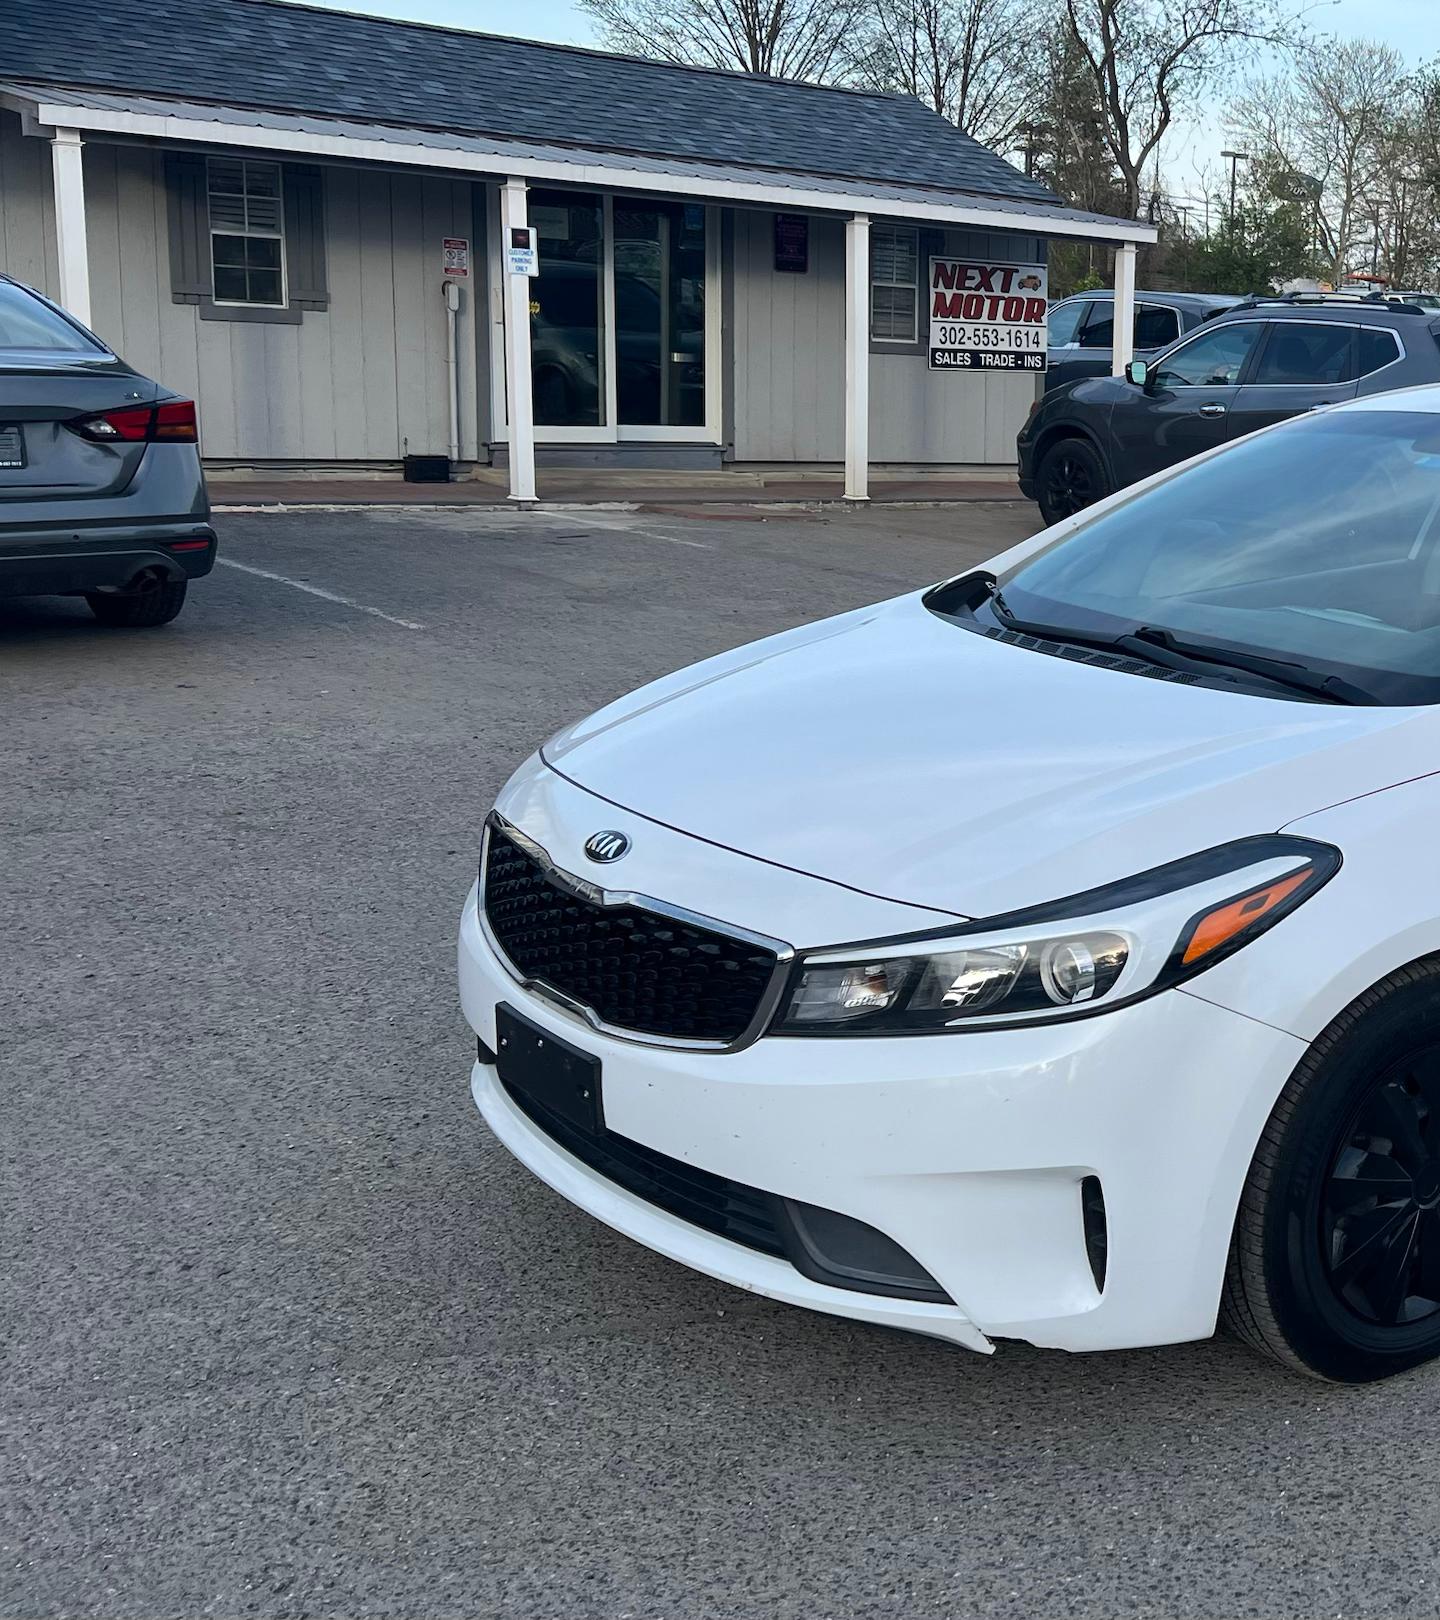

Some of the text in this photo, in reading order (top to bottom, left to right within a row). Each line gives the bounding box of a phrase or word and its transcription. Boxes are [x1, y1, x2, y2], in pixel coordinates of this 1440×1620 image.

[932, 262, 1019, 293] NEXT
[932, 292, 1047, 323] MOTOR
[939, 326, 1040, 348] 302-553-1614
[935, 351, 971, 365] SALES
[586, 832, 623, 858] KIA
